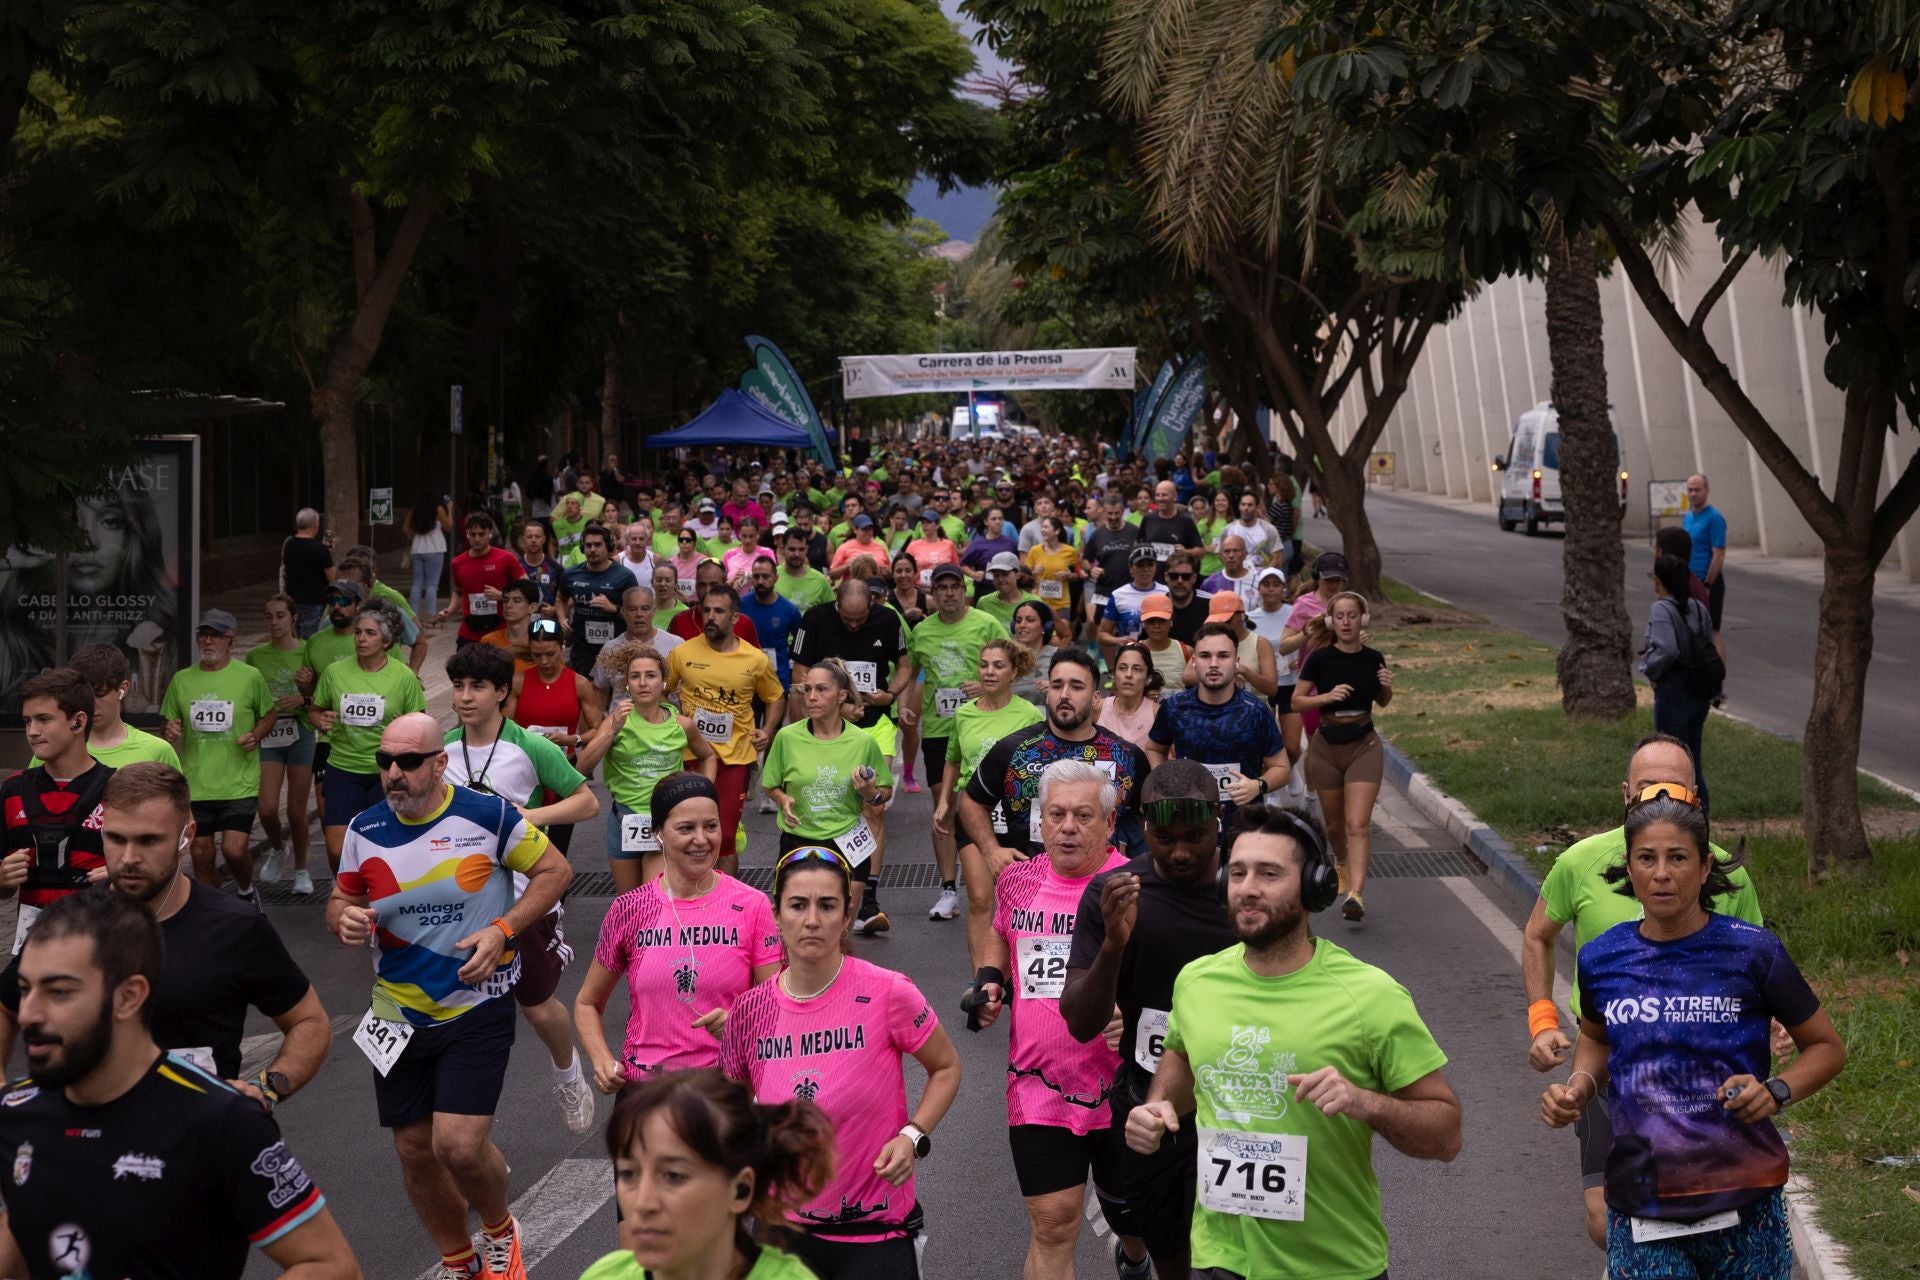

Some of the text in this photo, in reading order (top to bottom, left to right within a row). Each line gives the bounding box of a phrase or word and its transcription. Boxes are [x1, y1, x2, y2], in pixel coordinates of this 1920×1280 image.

[919, 356, 972, 368] Carrera
[976, 355, 994, 366] de
[1014, 353, 1063, 365] Prensa
[1171, 384, 1204, 432] Unicaja
[95, 594, 157, 608] GLOSSY
[27, 610, 36, 621] 4
[39, 609, 69, 621] DÍA
[589, 628, 609, 637] 808
[195, 711, 226, 722] 410
[345, 704, 377, 717] 409
[697, 719, 727, 734] 600
[846, 826, 871, 852] 1667
[399, 902, 465, 915] Málaga
[419, 912, 463, 926] 2024
[1011, 908, 1044, 934] DONA
[636, 925, 739, 948] DONA MEDULA
[1663, 995, 1742, 1013] XTREME
[1663, 1011, 1740, 1024] TRIATHLON
[366, 1016, 398, 1054] 341
[756, 1024, 865, 1061] DONA MEDULA
[1228, 1136, 1272, 1153] Carrera
[1211, 1157, 1287, 1193] 716
